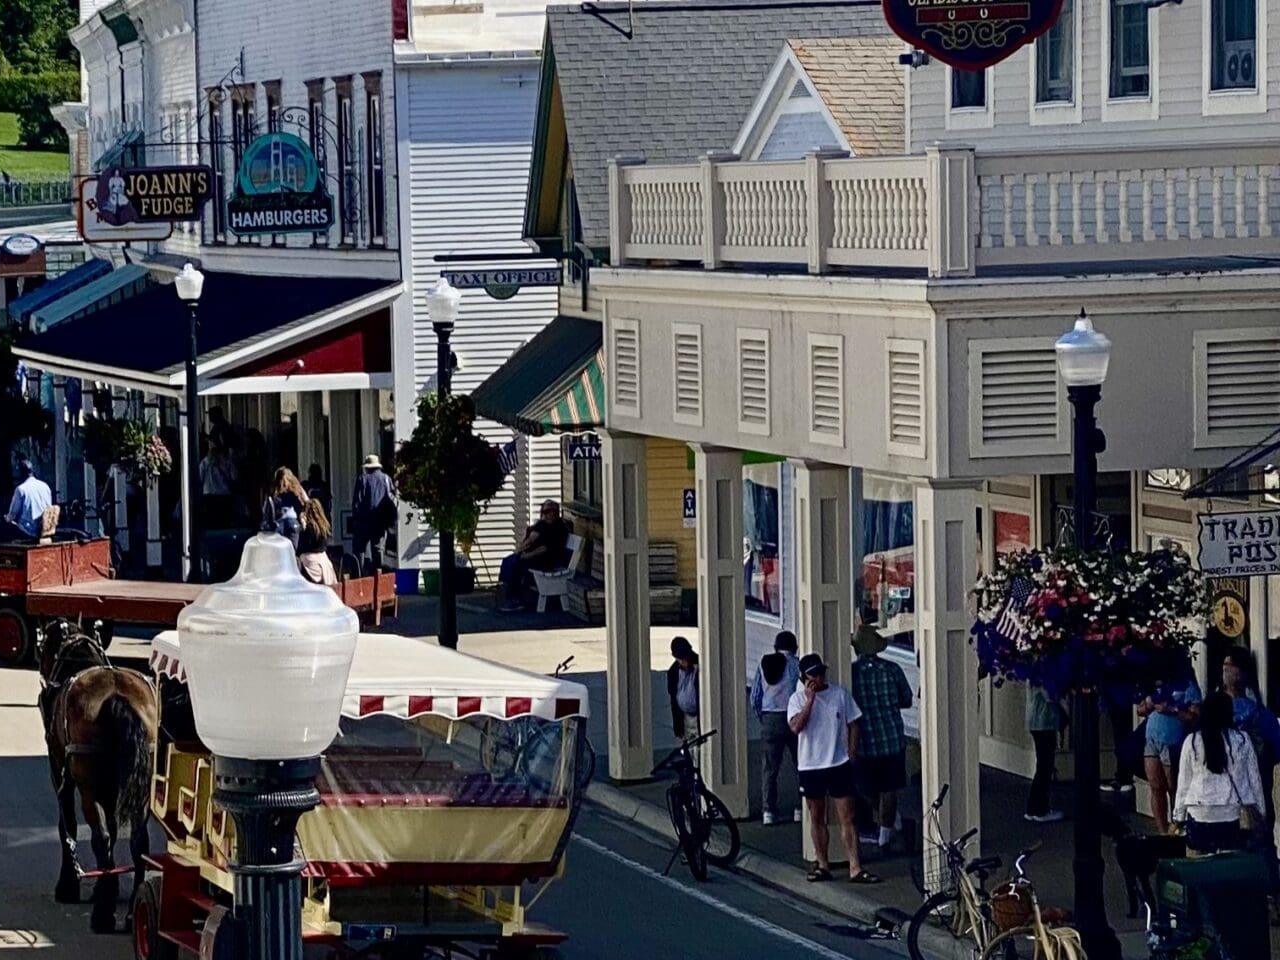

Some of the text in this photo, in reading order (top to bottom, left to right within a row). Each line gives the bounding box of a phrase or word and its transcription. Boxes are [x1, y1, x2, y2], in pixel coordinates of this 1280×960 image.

[126, 172, 207, 196] JOANN'S
[141, 196, 193, 216] FUDGE
[232, 208, 328, 228] HAMBURGERS
[447, 271, 558, 285] TAXI OFFICE
[572, 446, 602, 458] ATM
[685, 490, 695, 517] ATM
[1227, 540, 1280, 565] POS
[1235, 565, 1266, 574] PRICES
